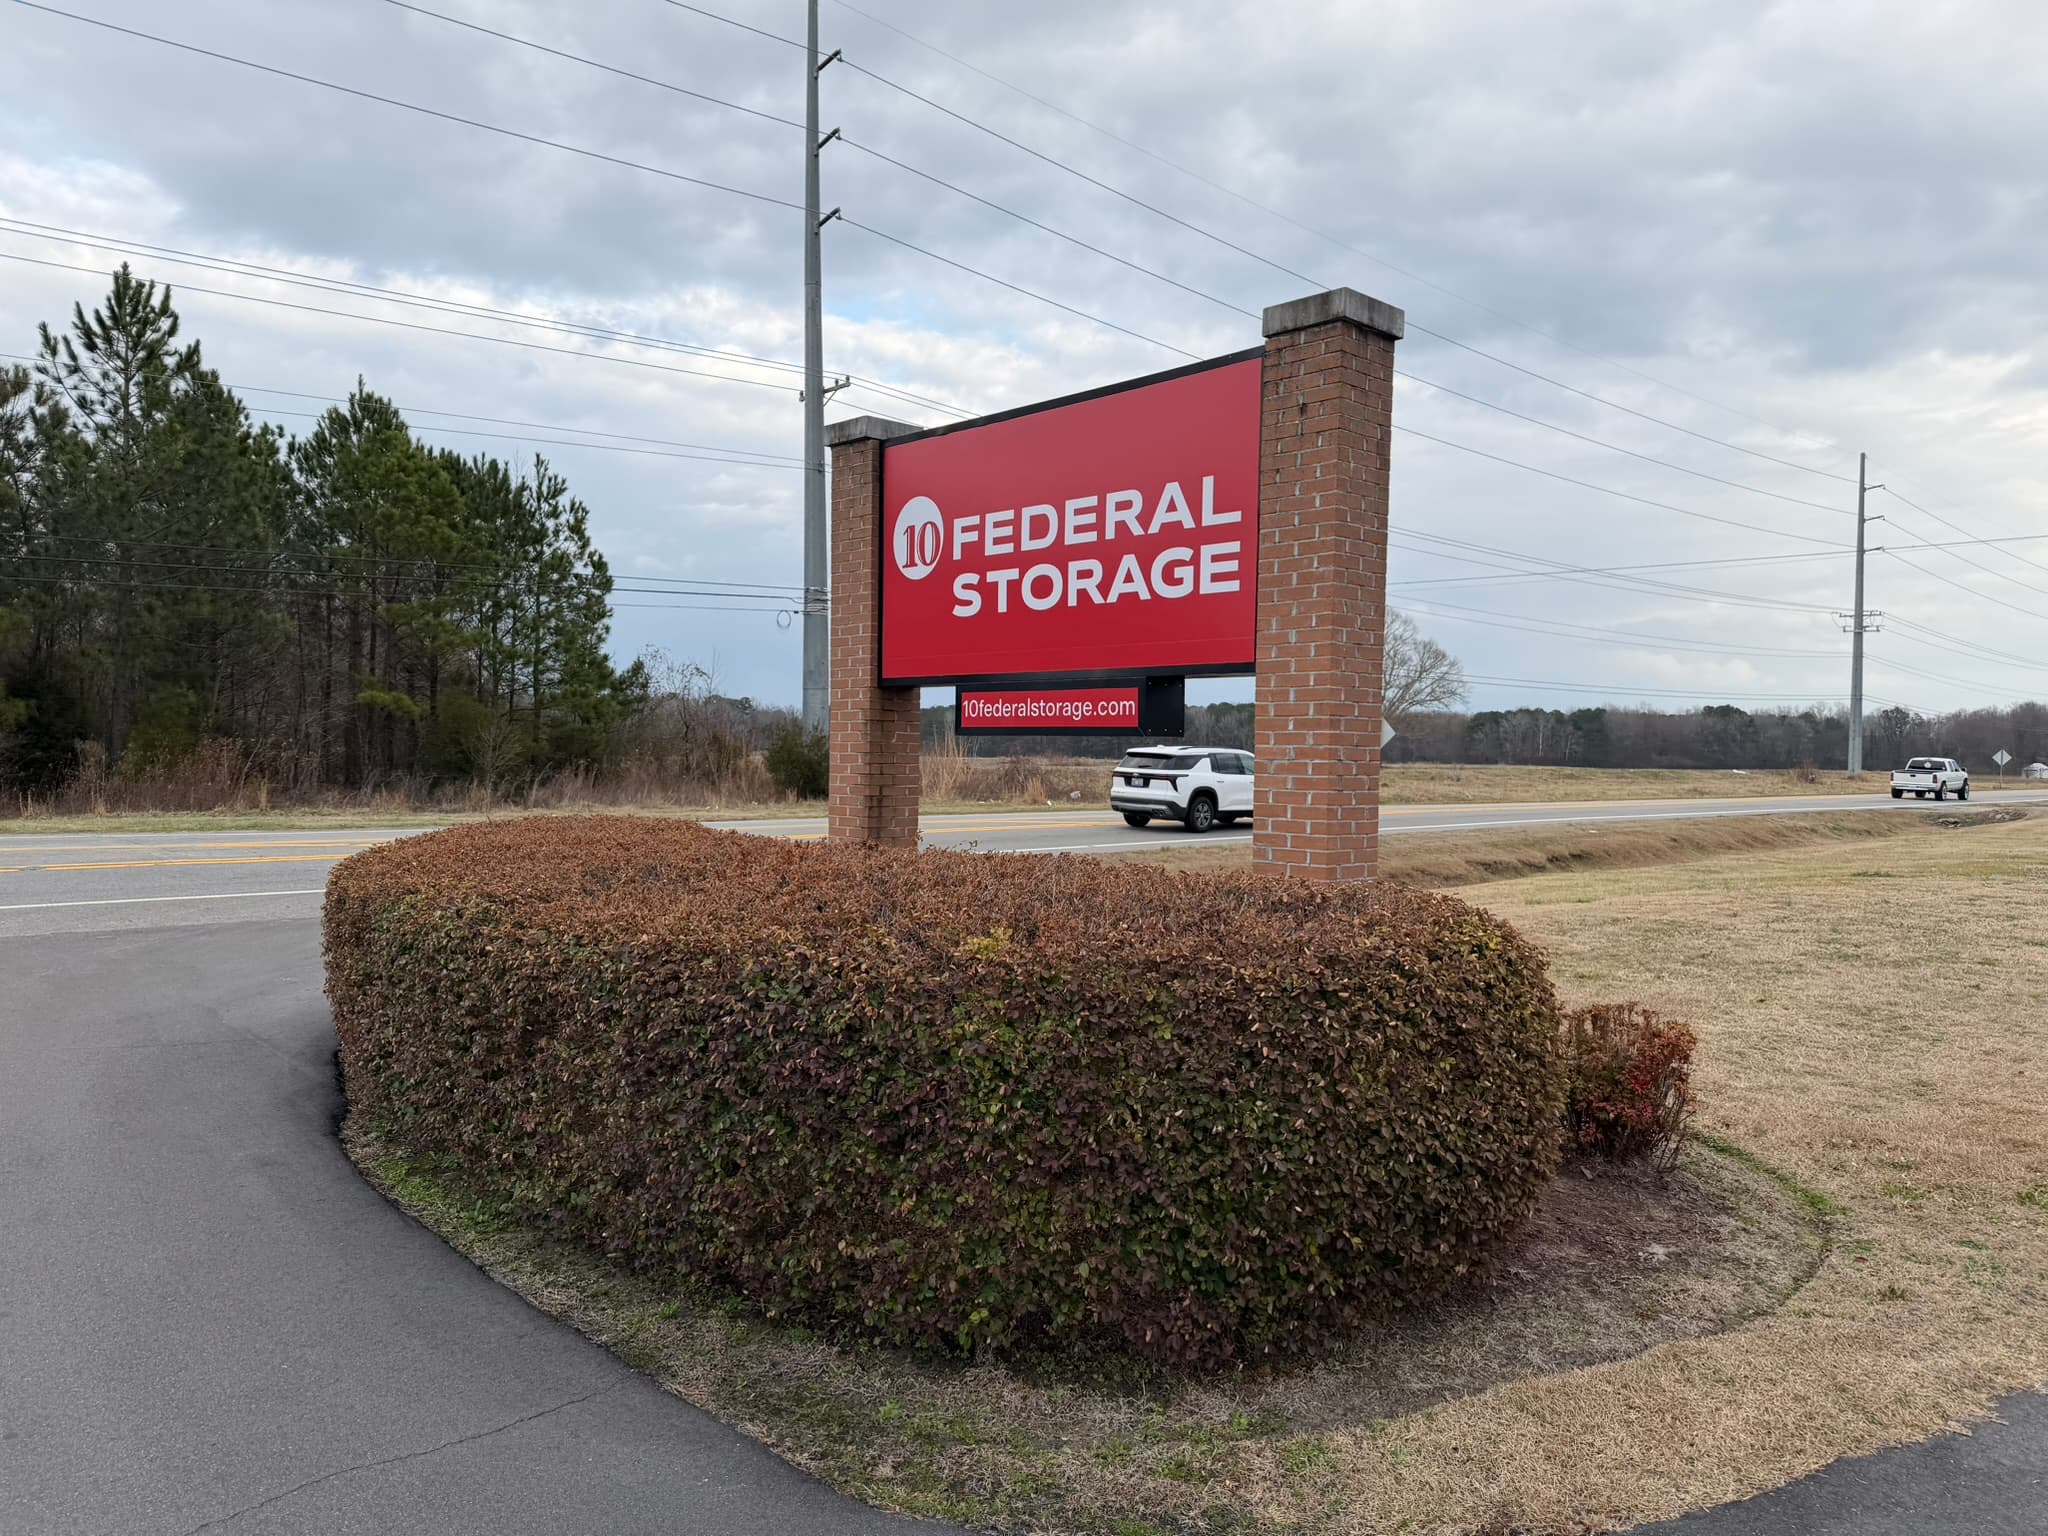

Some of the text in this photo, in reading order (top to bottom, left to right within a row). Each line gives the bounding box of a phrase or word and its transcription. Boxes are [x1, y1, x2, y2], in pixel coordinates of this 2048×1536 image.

[902, 475, 1242, 569] 10 FEDERAL
[952, 541, 1241, 617] STORAGE
[962, 698, 1136, 720] 10federalstorage.com
